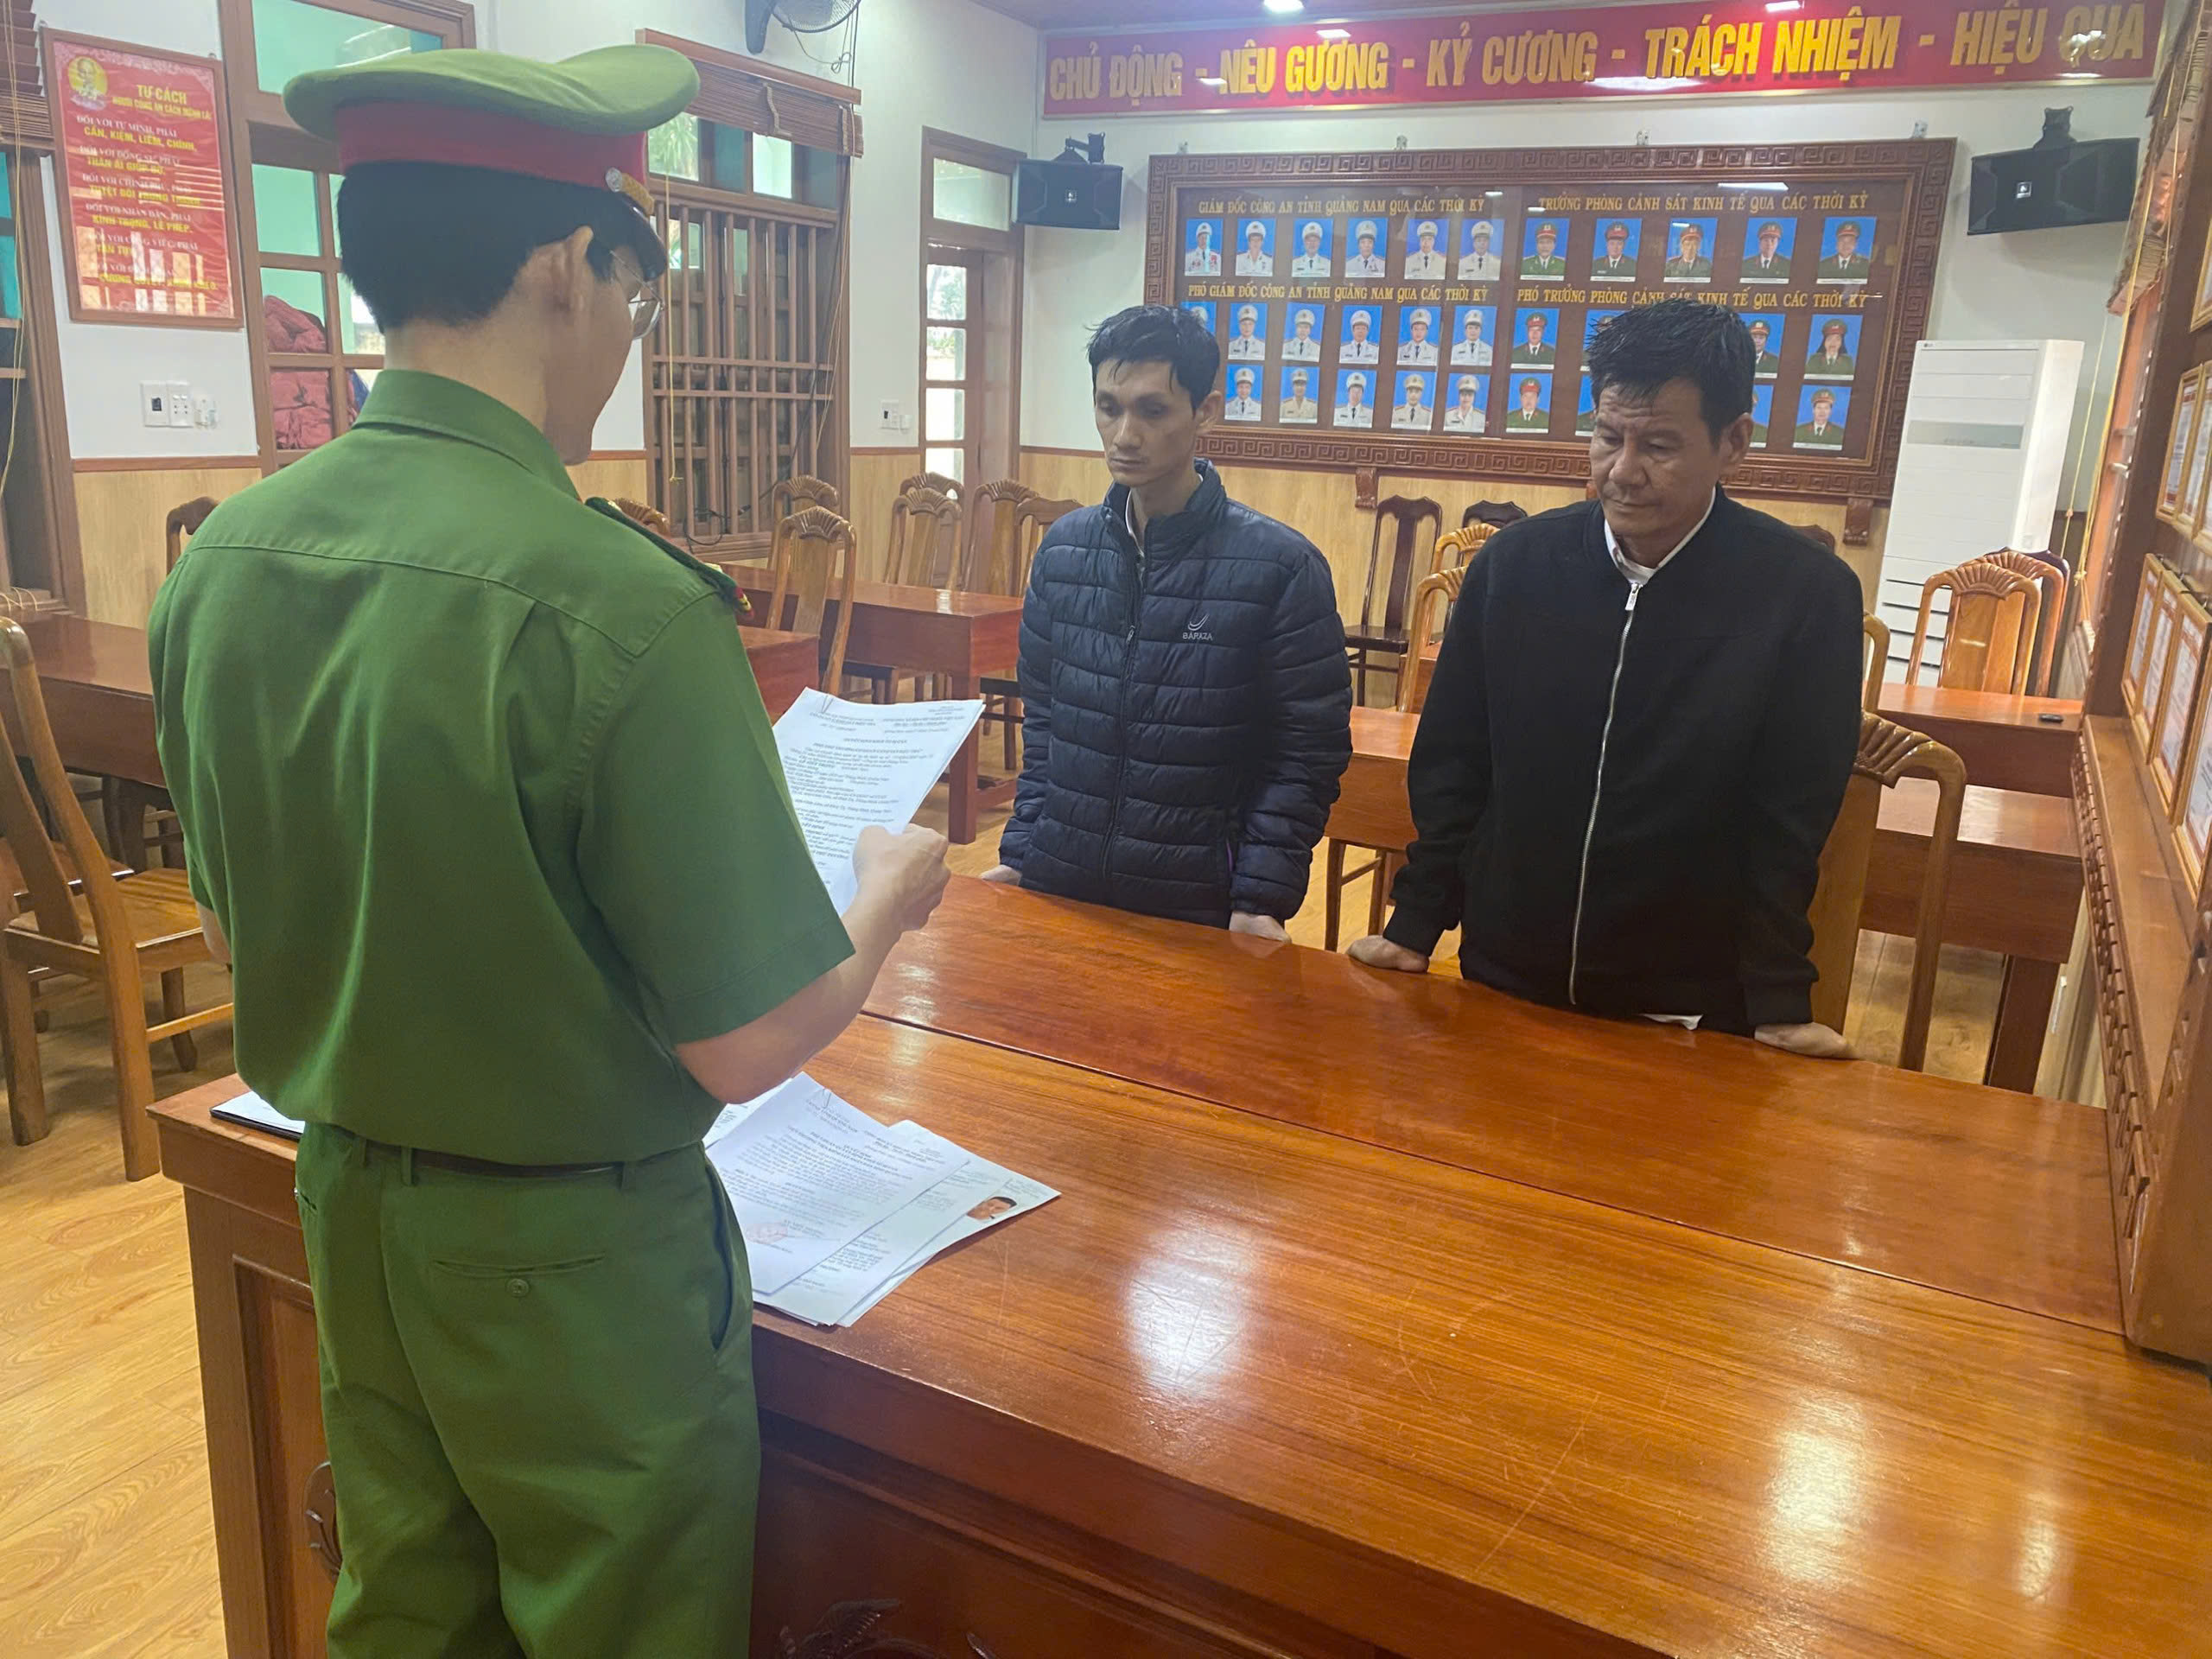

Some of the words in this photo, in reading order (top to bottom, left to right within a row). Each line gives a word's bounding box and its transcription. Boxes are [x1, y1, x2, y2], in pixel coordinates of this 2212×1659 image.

[1050, 41, 1102, 100] CHỦ
[1109, 45, 1183, 106] ĐỘNG
[1219, 39, 1277, 94] NÊU
[1285, 39, 1389, 94] GƯƠNG
[1427, 21, 1472, 86] KỶ
[1482, 29, 1598, 85] CƯƠNG
[1645, 14, 1763, 79] TRÁCH
[1772, 6, 1901, 81] NHIỆM
[1950, 0, 2049, 75] HIỆU
[156, 86, 187, 105] CÁCH
[1198, 198, 1224, 213] GIÁM
[1227, 196, 1246, 213] ĐỐC
[1250, 198, 1274, 213] CÔNG
[1279, 200, 1294, 213] AN
[1298, 195, 1322, 214] TỈNH
[1326, 195, 1359, 215] QUẢNG
[1363, 200, 1386, 213] NAM
[1389, 200, 1410, 215] QUA
[1414, 196, 1435, 213] CÁC
[1440, 194, 1465, 213] THỜI
[1539, 192, 1581, 210] TRƯỞNG
[1586, 194, 1623, 210] PHÒNG
[1628, 193, 1661, 210] CẢNH
[1665, 193, 1688, 210] SÁT
[1693, 197, 1724, 210] KINH
[1730, 190, 1748, 210] TẾ
[1750, 195, 1775, 213] QUA
[1782, 192, 1808, 210] CÁC
[1813, 190, 1844, 209] THỜI
[1188, 281, 1206, 296] PHÓ
[1210, 282, 1236, 297] GIÁM
[1238, 280, 1258, 297] ĐỐC
[1261, 283, 1285, 298] CÔNG
[1288, 287, 1302, 298] AN
[1306, 282, 1331, 298] TỈNH
[1334, 283, 1368, 302] QUẢNG
[1371, 287, 1394, 300] NAM
[1396, 287, 1417, 302] QUA
[1421, 284, 1441, 301] CÁC
[1445, 284, 1470, 301] THỜI
[1516, 284, 1539, 302] PHÓ
[1543, 283, 1586, 302] TRƯỞNG
[1590, 287, 1627, 304] PHÒNG
[1733, 286, 1751, 306] TẾ
[1753, 293, 1777, 310] QUA
[1783, 290, 1808, 307] CÁC
[1814, 289, 1842, 308] THỜI
